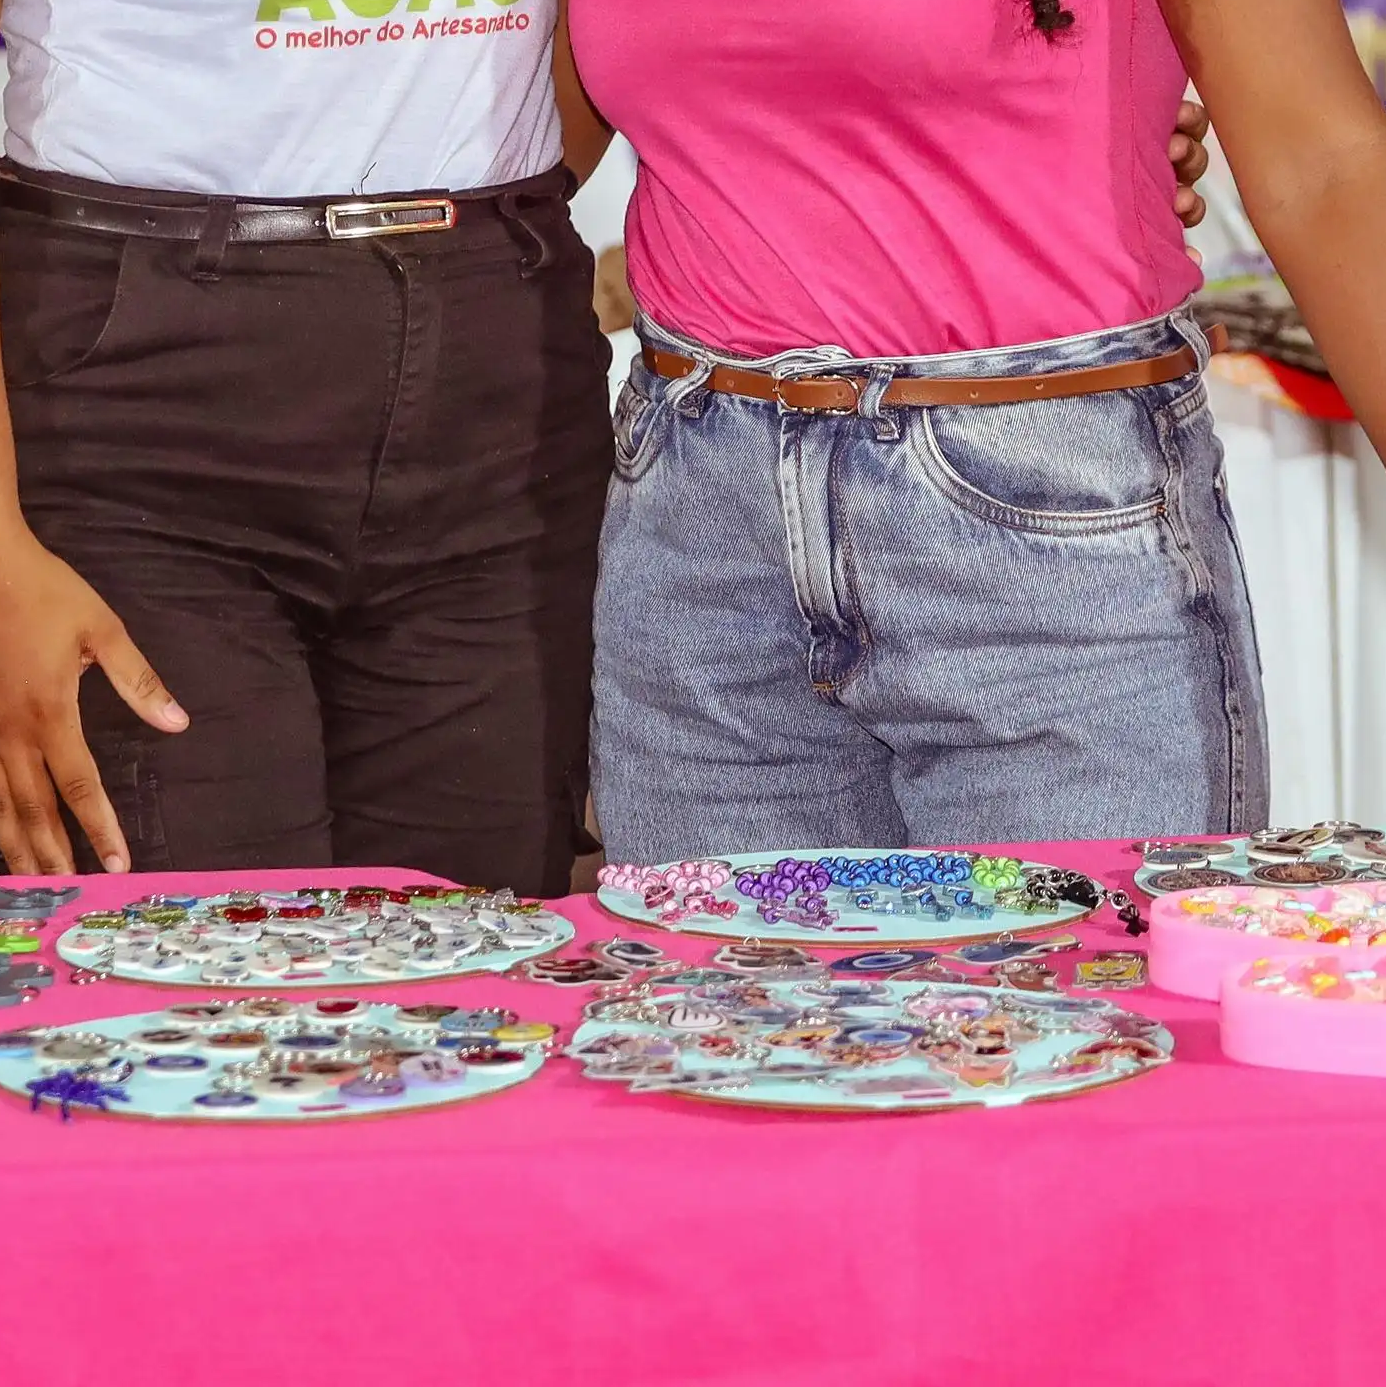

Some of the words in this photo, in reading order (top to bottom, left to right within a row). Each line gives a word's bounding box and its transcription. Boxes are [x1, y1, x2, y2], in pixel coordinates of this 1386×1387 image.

[255, 27, 278, 50] O
[286, 25, 372, 49] melhor
[376, 19, 405, 42] do
[412, 9, 530, 40] Artesanato
